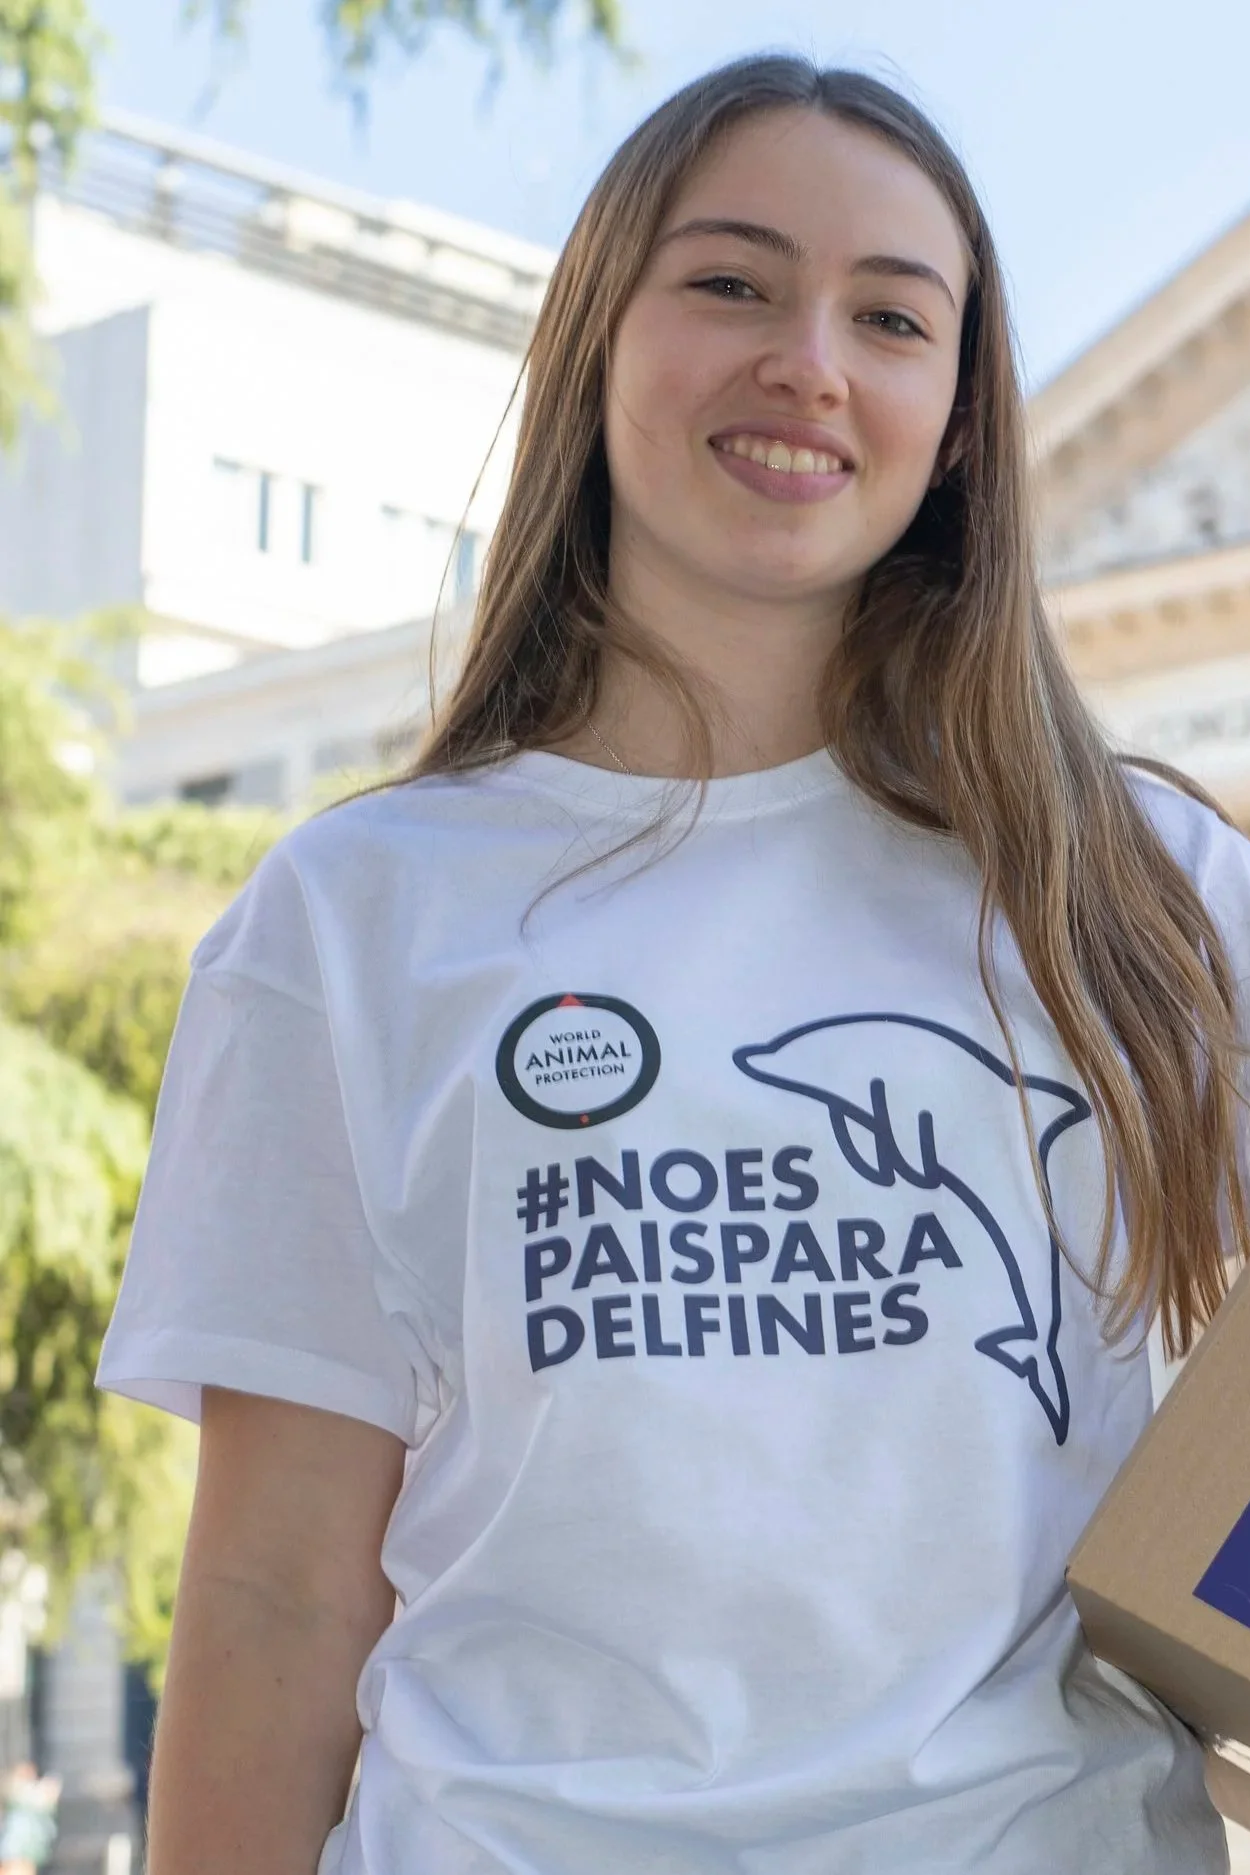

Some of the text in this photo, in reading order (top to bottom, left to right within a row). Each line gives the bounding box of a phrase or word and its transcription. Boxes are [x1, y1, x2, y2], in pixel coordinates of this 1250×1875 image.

[524, 1040, 632, 1071] ANIMAL
[549, 1029, 601, 1045] WORLD
[535, 1063, 625, 1086] PROTECTION
[516, 1145, 820, 1235] #NOES
[524, 1211, 965, 1304] PAISPARA
[526, 1282, 930, 1375] DELFINES
